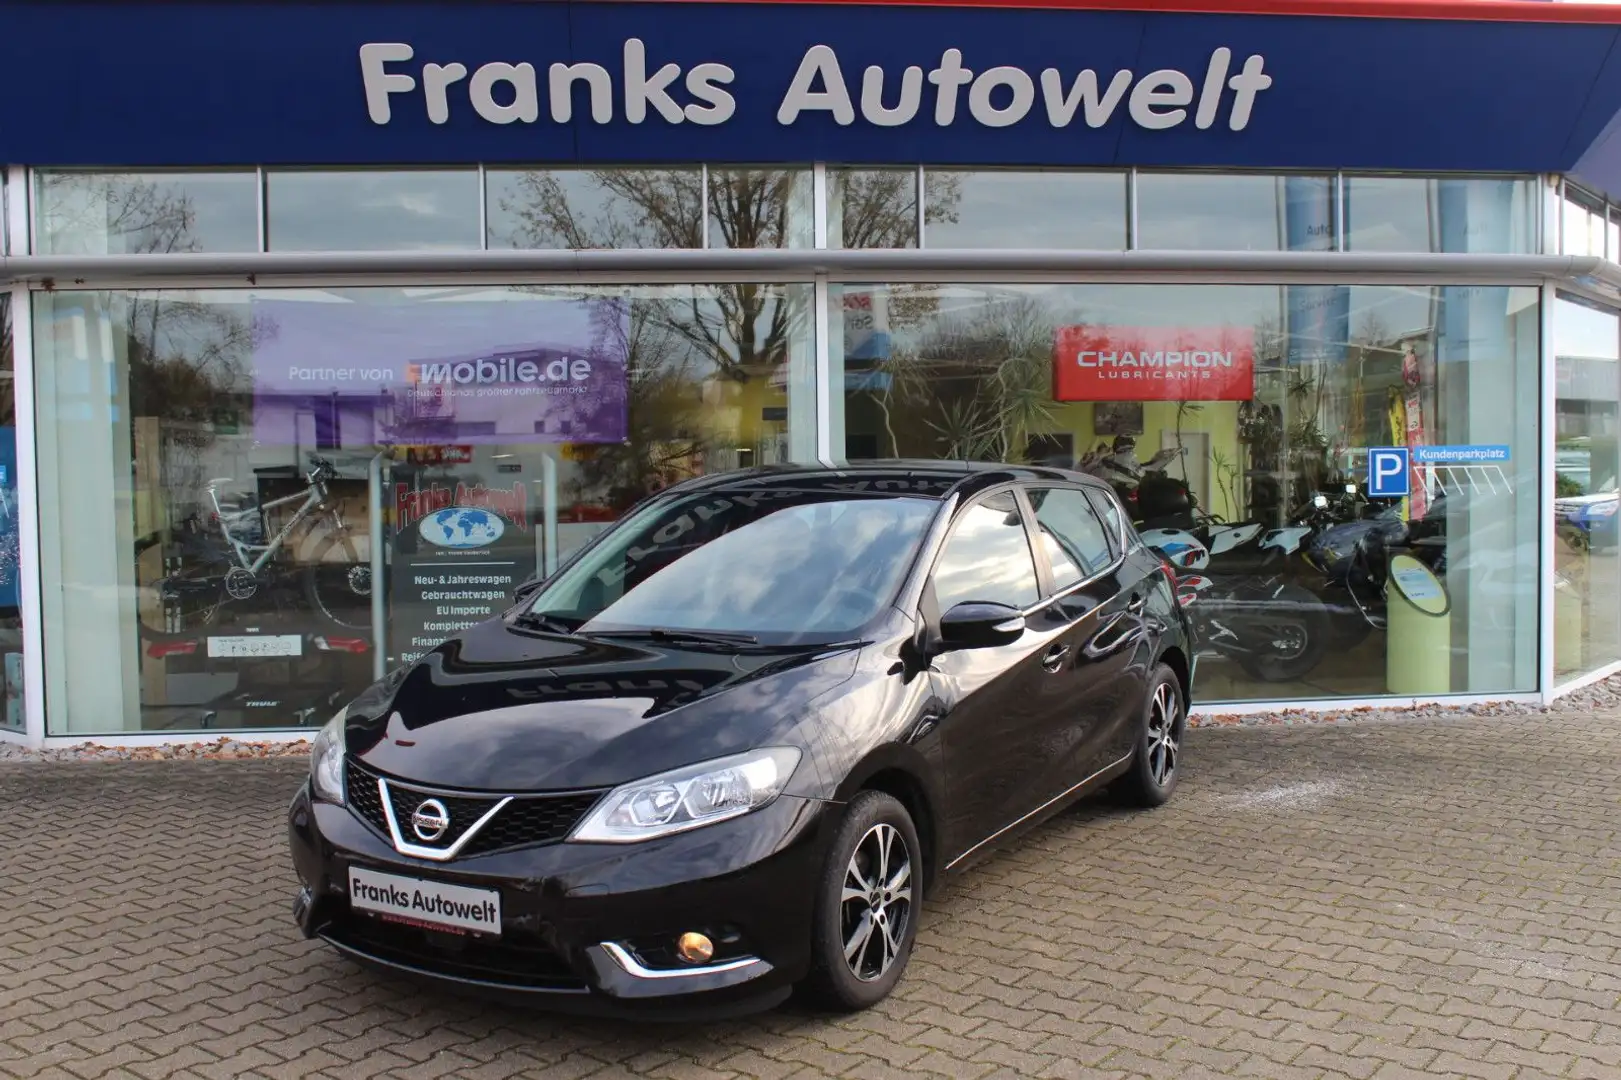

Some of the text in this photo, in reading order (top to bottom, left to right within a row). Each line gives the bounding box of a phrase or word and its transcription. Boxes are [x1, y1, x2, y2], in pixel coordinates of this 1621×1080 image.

[359, 38, 1272, 131] Franks Autowelt
[1077, 351, 1232, 367] CHAMPION
[289, 356, 592, 384] Partner von mobile.de
[1098, 370, 1211, 379] LUBRICANTS
[1419, 449, 1505, 460] Kundenparkplatz
[1375, 453, 1402, 490] P
[414, 575, 511, 585] Neu- & Jahreswagen
[421, 590, 505, 600] Gebrauchtwagen
[436, 606, 491, 616] EU Importe
[352, 877, 496, 923] Franks Autowelt
